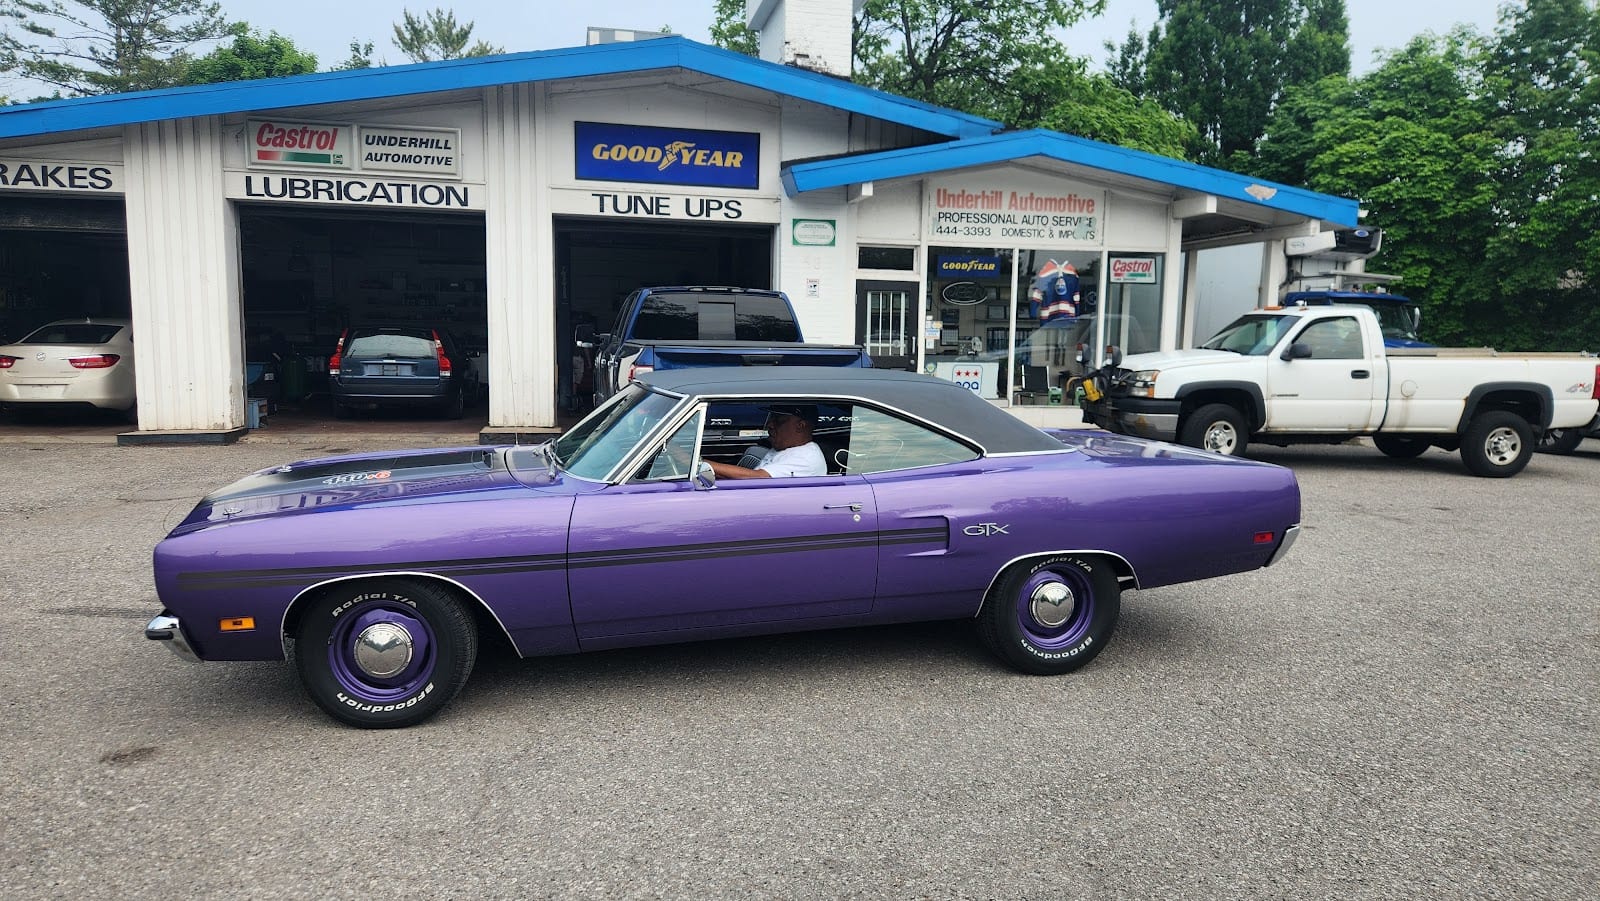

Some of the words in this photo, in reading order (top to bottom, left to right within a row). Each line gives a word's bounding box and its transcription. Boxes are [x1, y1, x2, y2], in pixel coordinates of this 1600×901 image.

[256, 122, 338, 150] Castrol
[364, 134, 452, 150] UNDERHILL
[364, 152, 453, 166] AUTOMOTIVE
[245, 175, 469, 207] LUBRICATION
[592, 193, 671, 216] TUNE
[685, 198, 742, 219] UPS
[936, 188, 1003, 209] Underhill
[1008, 191, 1095, 214] Automotive
[938, 212, 1018, 225] PROFESSIONAL
[1021, 215, 1049, 226] AUTO
[1052, 215, 1093, 227] SERVIE
[936, 226, 991, 236] 444-3393
[1002, 228, 1045, 239] DOMESTIC
[1049, 230, 1054, 239] &
[1059, 230, 1095, 240] IMPTS
[1113, 259, 1152, 272] Castrol
[962, 522, 1010, 536] GTX
[1030, 557, 1072, 574] Radial
[332, 593, 387, 617] Radial
[392, 594, 418, 609] T/A
[336, 682, 435, 713] BFGoodrich
